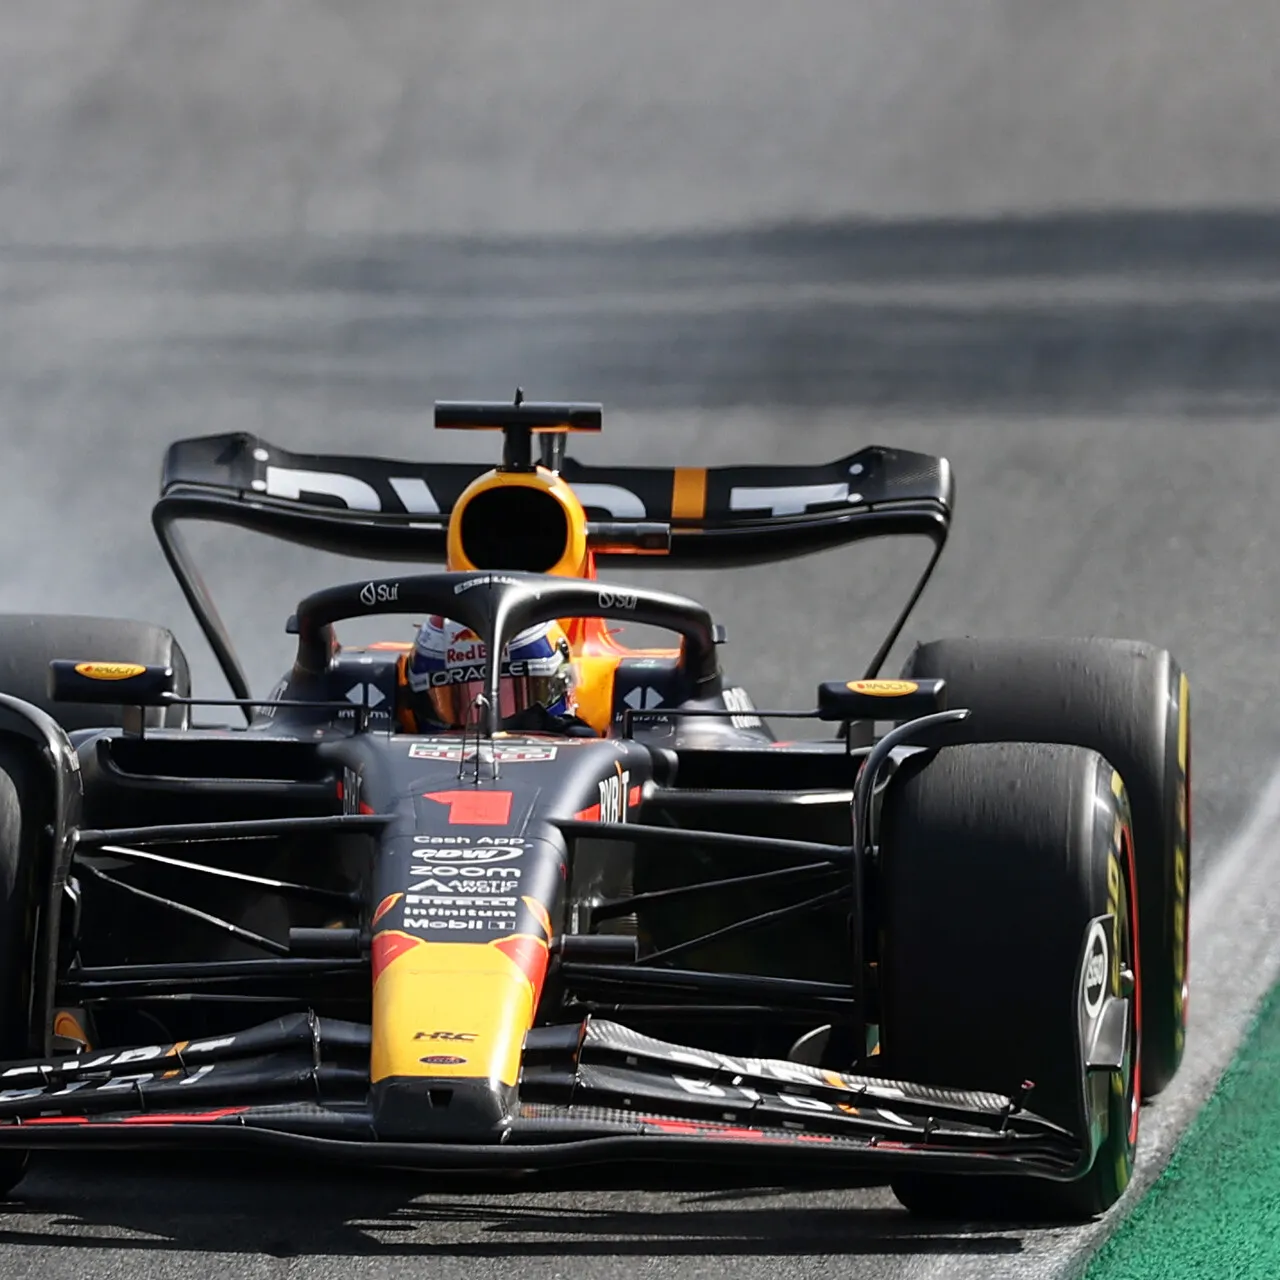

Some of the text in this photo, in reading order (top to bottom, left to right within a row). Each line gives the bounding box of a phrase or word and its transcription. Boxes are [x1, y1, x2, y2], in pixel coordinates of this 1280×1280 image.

[377, 582, 398, 601] Sui
[447, 646, 476, 663] Red
[422, 790, 513, 825] 1
[414, 835, 525, 845] Cash App
[412, 847, 510, 862] CDW
[409, 866, 521, 877] zoom
[448, 880, 519, 888] ARCTIC
[405, 894, 518, 906] PIRELLI
[404, 907, 517, 917] infinitum
[403, 918, 483, 929] Mobil
[412, 1031, 480, 1041] HRC
